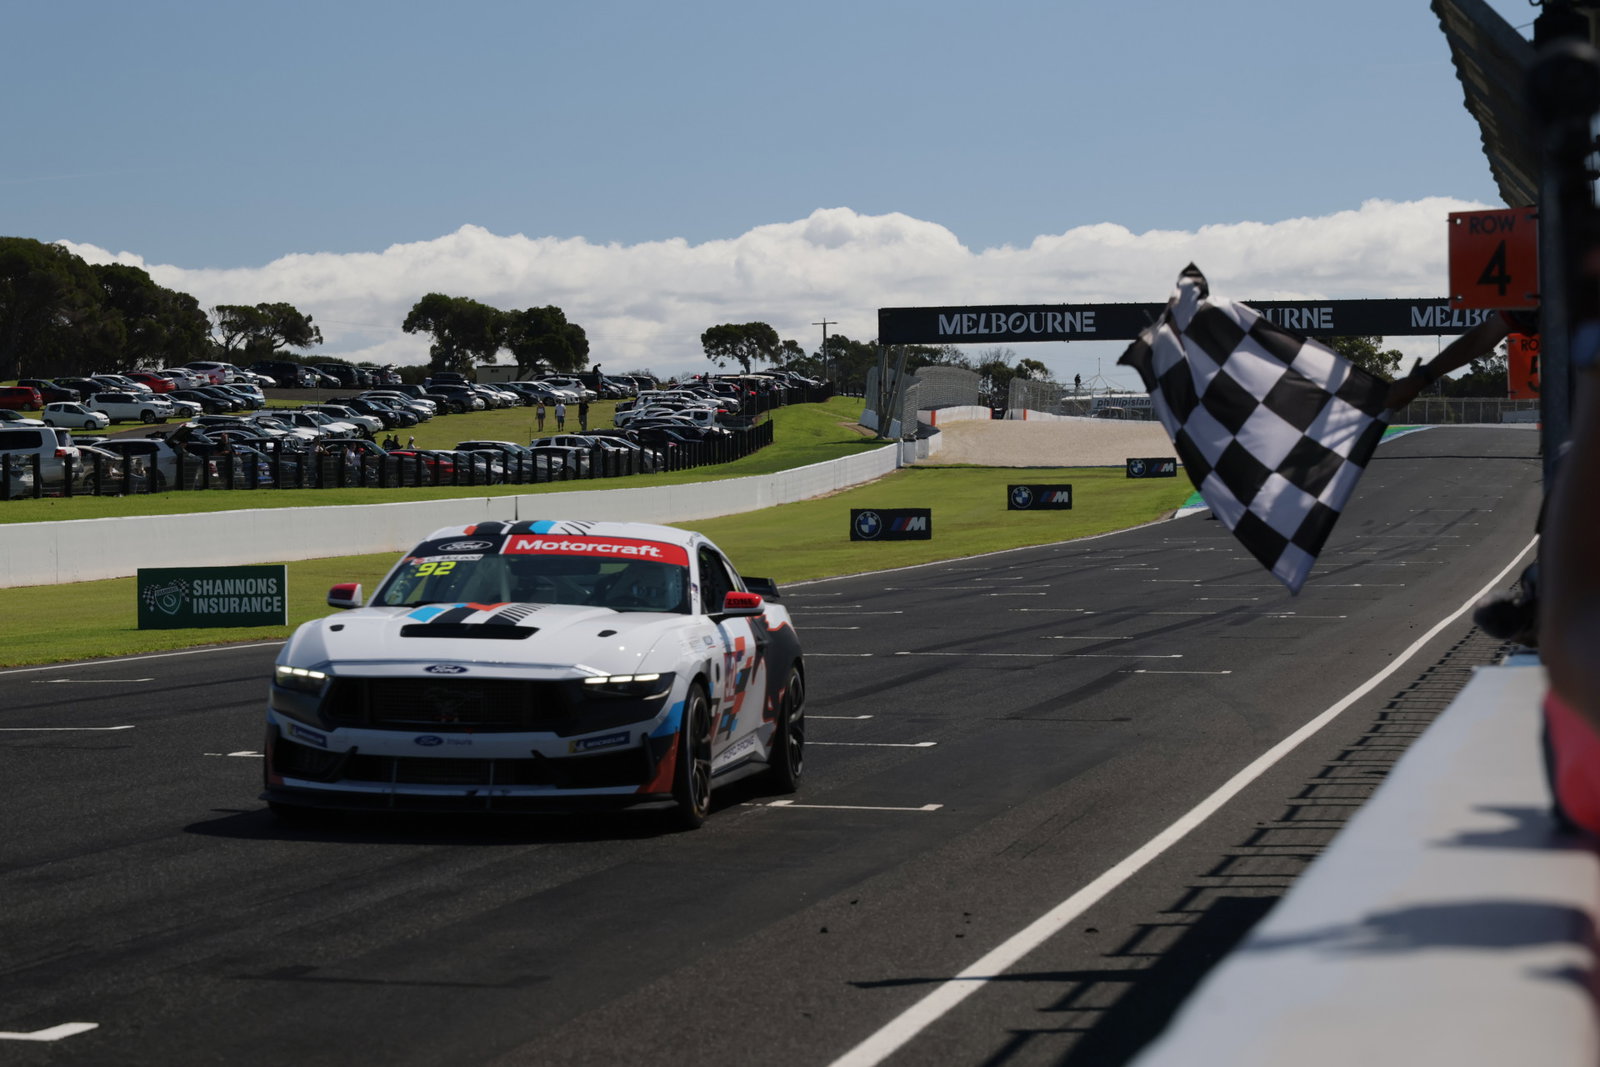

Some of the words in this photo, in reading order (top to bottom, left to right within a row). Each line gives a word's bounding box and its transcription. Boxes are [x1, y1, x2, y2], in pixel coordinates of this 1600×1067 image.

[1469, 215, 1516, 234] ROW
[1476, 239, 1512, 296] 4
[938, 311, 1096, 335] MELBOURNE
[1255, 307, 1334, 329] URNE
[1521, 338, 1539, 351] RO
[1097, 398, 1151, 407] phillipislan
[516, 540, 662, 558] Motorcraft
[415, 561, 457, 577] 92
[192, 578, 277, 596] SHANNONS
[192, 596, 282, 614] INSURANCE
